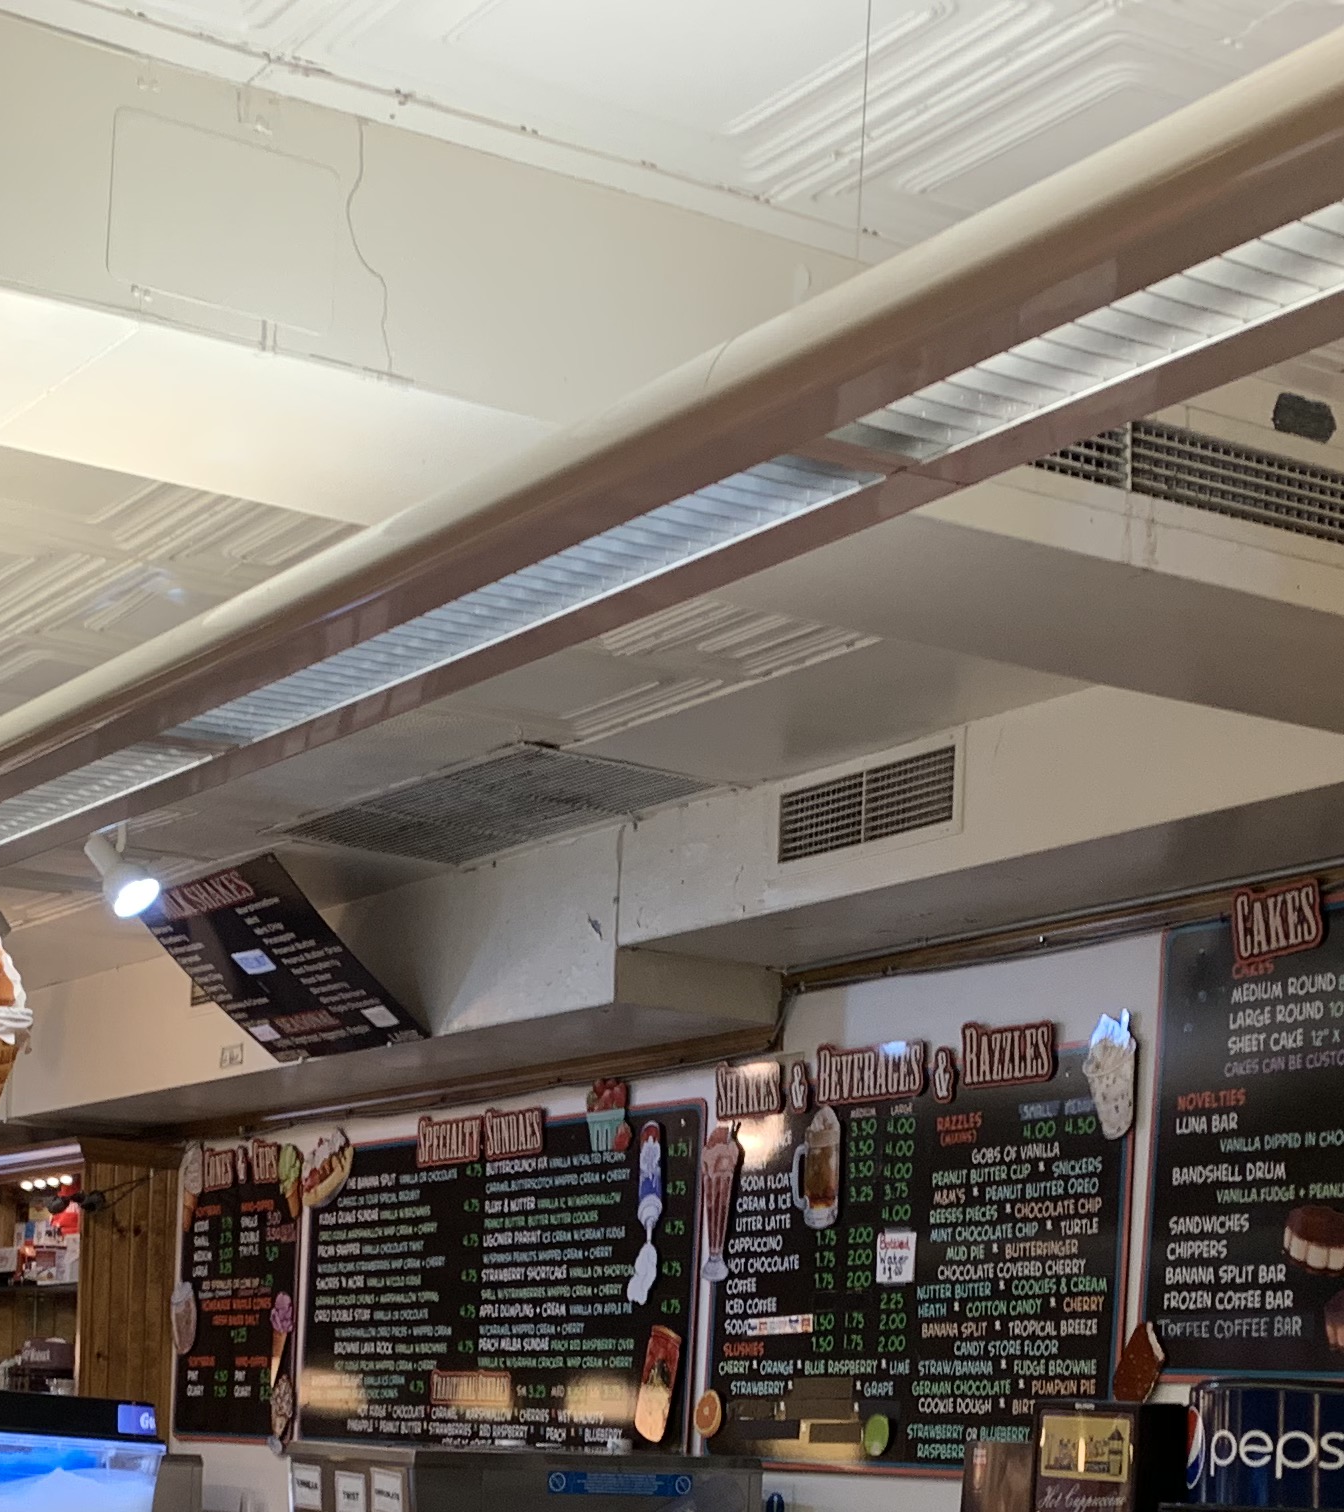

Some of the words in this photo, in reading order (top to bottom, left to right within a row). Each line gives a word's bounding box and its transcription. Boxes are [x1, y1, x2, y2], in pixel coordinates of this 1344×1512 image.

[1236, 885, 1317, 958] CAKES
[1231, 981, 1283, 1004] MEDIUM
[1288, 972, 1336, 995] ROUND
[1229, 1007, 1271, 1029] LARGE
[1276, 1001, 1324, 1023] ROUND
[1228, 1033, 1266, 1055] SHEET
[1270, 1028, 1304, 1050] CAKE
[717, 1068, 778, 1117] SHAKES
[791, 1064, 805, 1108] &
[819, 1045, 920, 1101] BEVERAGES
[935, 1051, 949, 1098] &
[964, 1027, 1049, 1084] RAZZLES
[1224, 1059, 1259, 1077] CAKES
[1263, 1057, 1284, 1073] CAN
[1289, 1054, 1302, 1070] BE
[1178, 1088, 1246, 1111] NOVELTIES
[1176, 1115, 1207, 1135] LUNA
[1212, 1112, 1238, 1133] BAR
[418, 1120, 480, 1162] SPECIALTY
[486, 1111, 541, 1156] SUNDAES
[1220, 1136, 1261, 1153] VANILLA
[1265, 1132, 1302, 1151] DIPPED
[1306, 1131, 1316, 1147] IN
[972, 1146, 1001, 1164] GOBS
[1020, 1141, 1059, 1160] VANILLA
[1172, 1164, 1242, 1185] BANDSHELL
[1247, 1162, 1286, 1181] DRUM
[1169, 1213, 1249, 1235] SANDWICHES
[728, 1234, 783, 1254] CAPPUCCINO
[1167, 1240, 1227, 1260] CHIPPERS
[938, 1262, 994, 1280] CHOCOLATE
[997, 1260, 1042, 1278] COVERED
[1045, 1258, 1086, 1276] CHERRY
[1166, 1266, 1214, 1285] BANANA
[1219, 1265, 1254, 1284] SPLIT
[1259, 1264, 1285, 1283] BAR
[1011, 1278, 1056, 1296] COOKIES
[1071, 1276, 1107, 1293] CREAM
[1164, 1291, 1211, 1310] FROZEN
[1216, 1290, 1261, 1310] COFFEE
[1265, 1290, 1293, 1309] BAR
[1008, 1320, 1056, 1337] TROPICAL
[1060, 1318, 1097, 1336] BREEZE
[1157, 1319, 1209, 1338] TOFFEE
[1214, 1318, 1269, 1339] COFFEE
[1274, 1316, 1302, 1337] BAR
[954, 1341, 985, 1356] CANDY
[988, 1340, 1021, 1357] STORE
[1024, 1339, 1058, 1355] FLOOR
